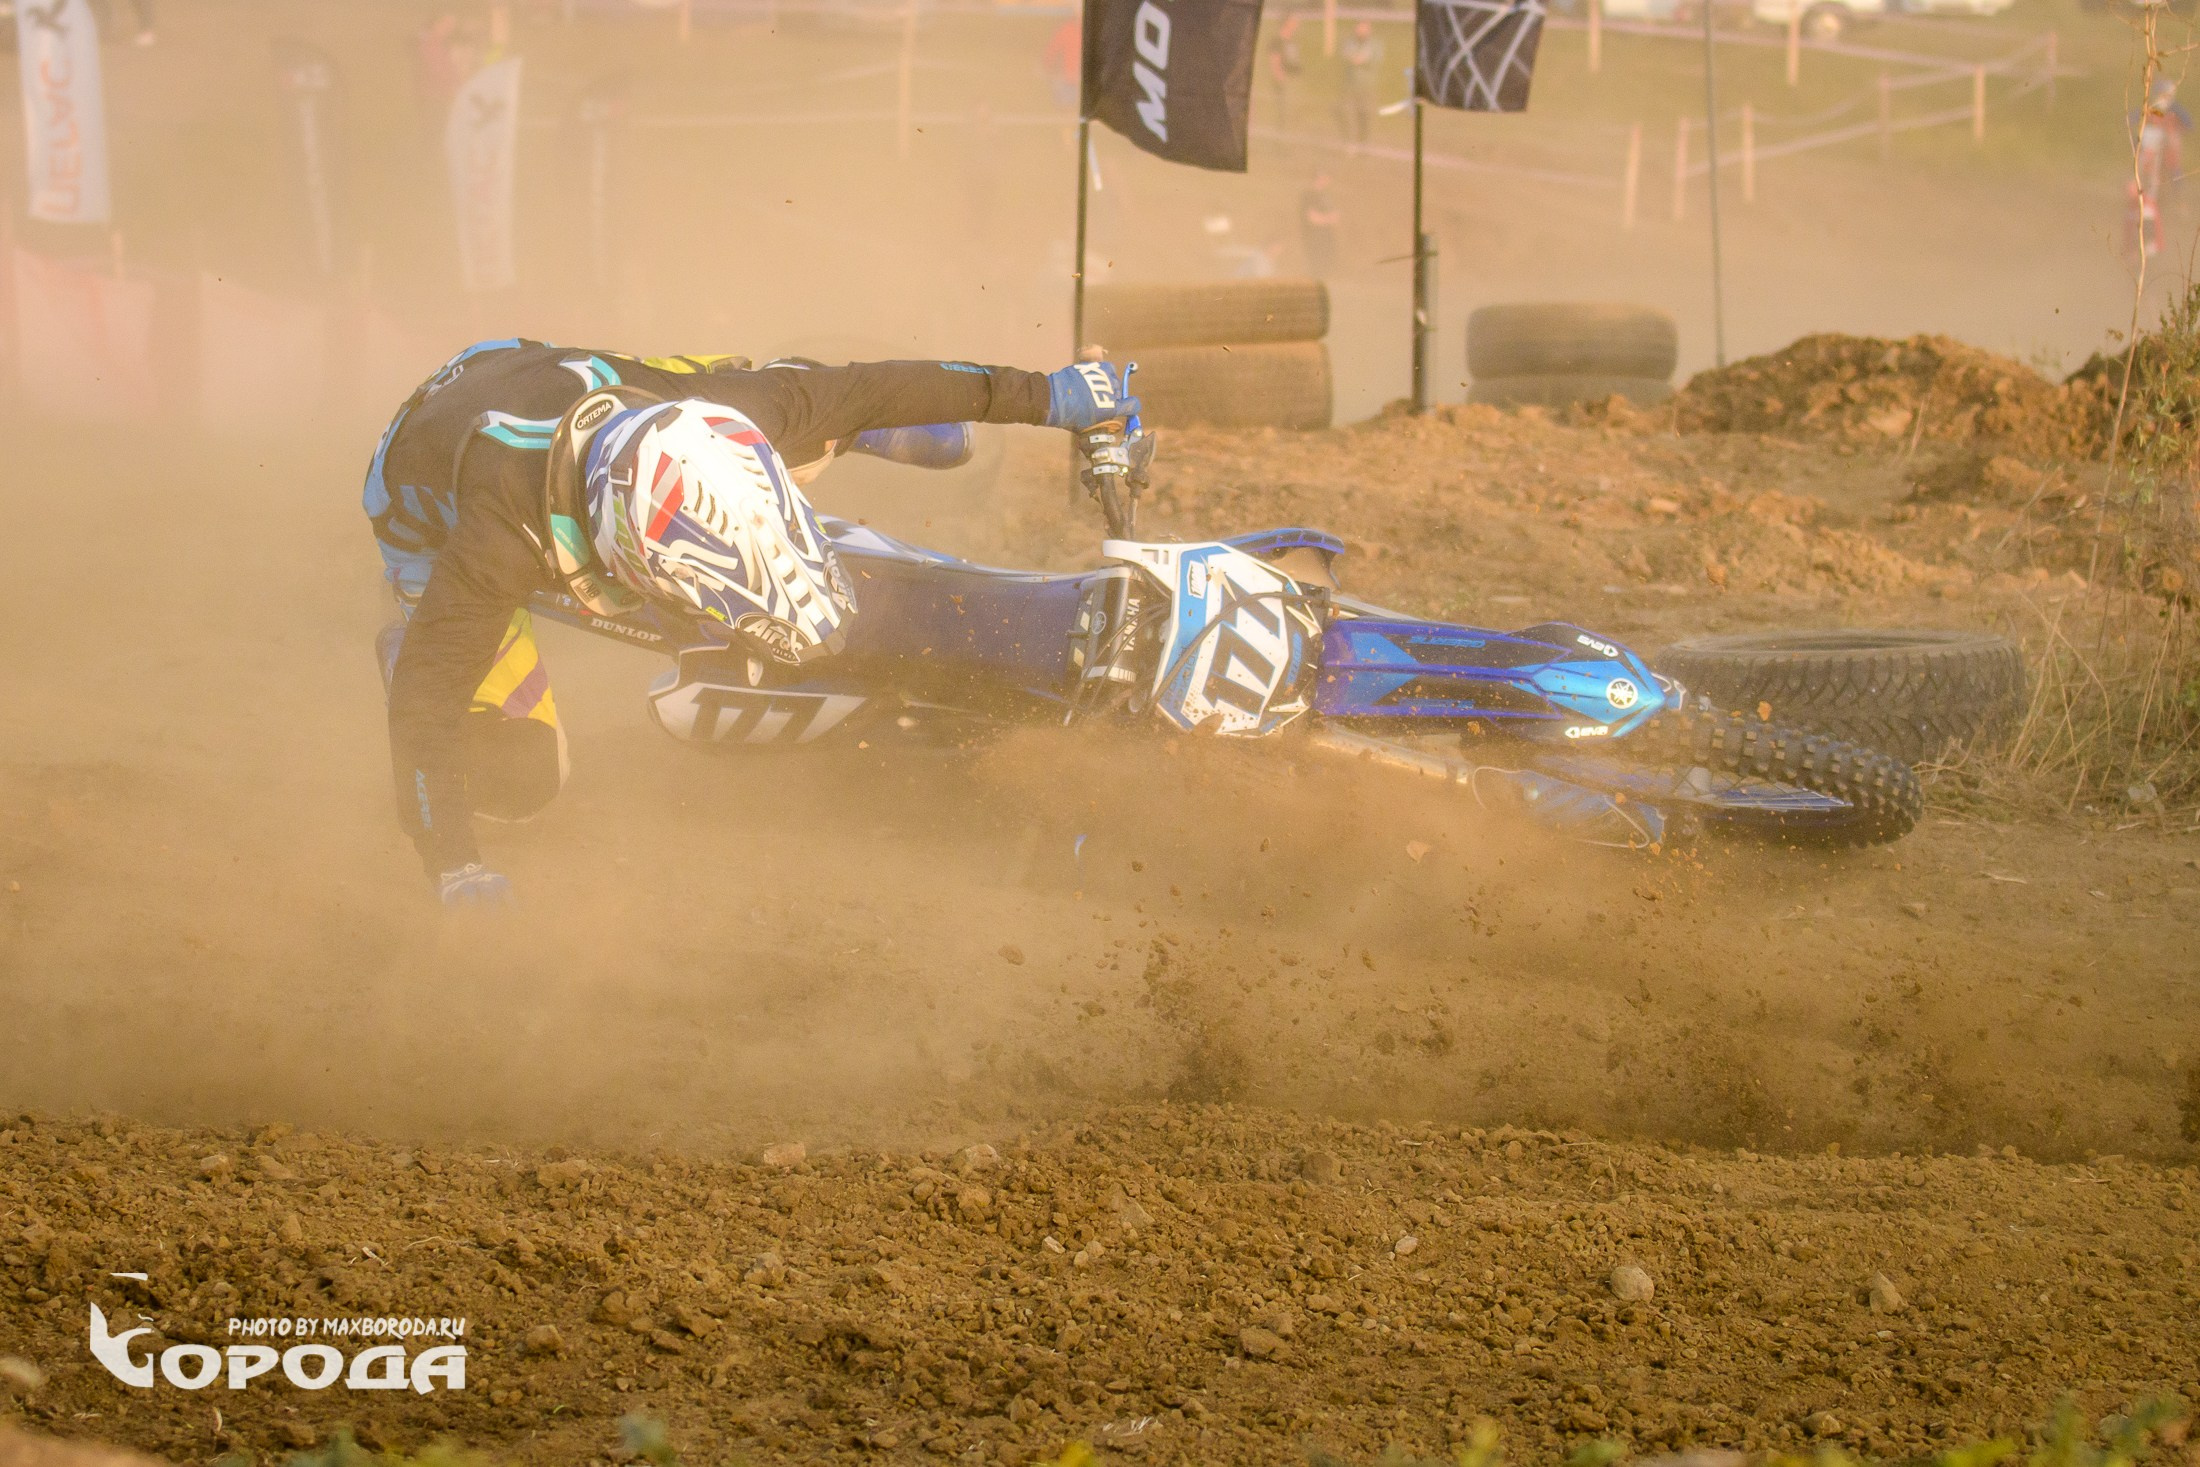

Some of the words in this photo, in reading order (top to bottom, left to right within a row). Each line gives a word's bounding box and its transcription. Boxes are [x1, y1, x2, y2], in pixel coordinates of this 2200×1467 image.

[1131, 0, 1173, 144] MO
[1073, 362, 1116, 408] FOX
[576, 401, 612, 429] ORTEMA
[590, 617, 664, 643] DUNLOP
[689, 686, 829, 744] 177
